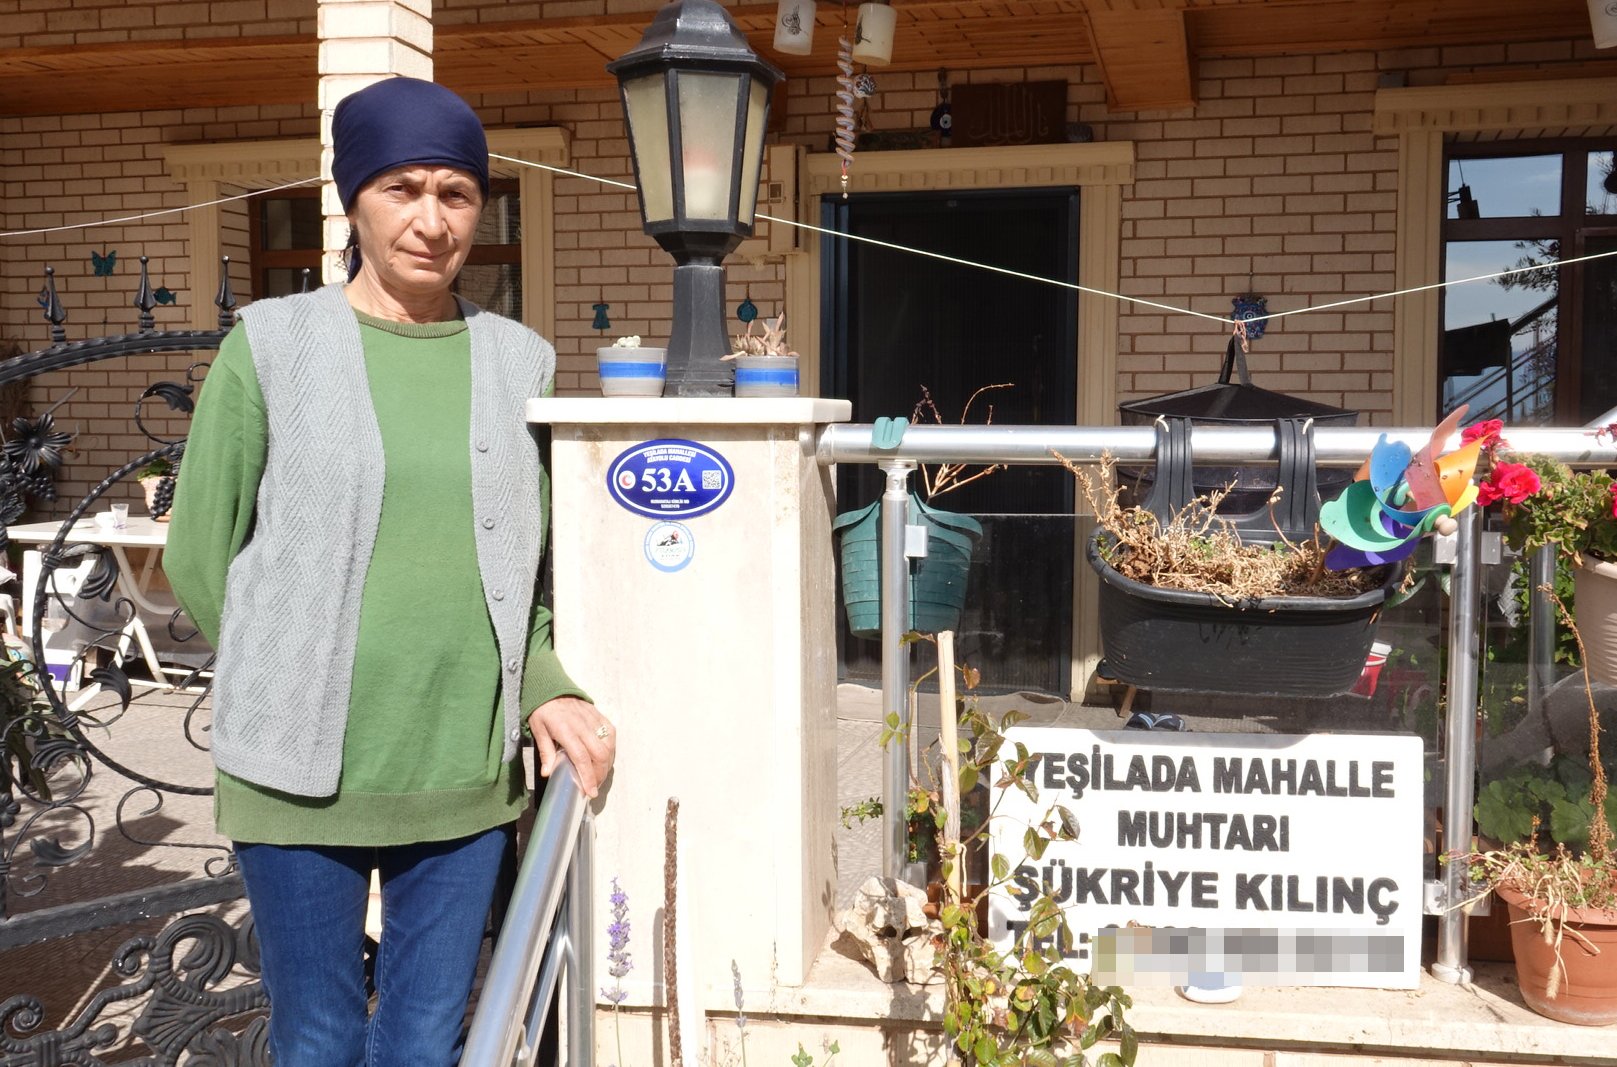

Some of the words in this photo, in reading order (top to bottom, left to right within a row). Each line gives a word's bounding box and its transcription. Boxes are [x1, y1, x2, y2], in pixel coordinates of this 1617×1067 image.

[641, 467, 697, 492] 53A
[1213, 757, 1395, 798] MAHALLE
[1118, 810, 1289, 852] MUHTARI
[1013, 859, 1219, 912] ŞÜKRİYE
[1235, 873, 1399, 925] KILINÇ
